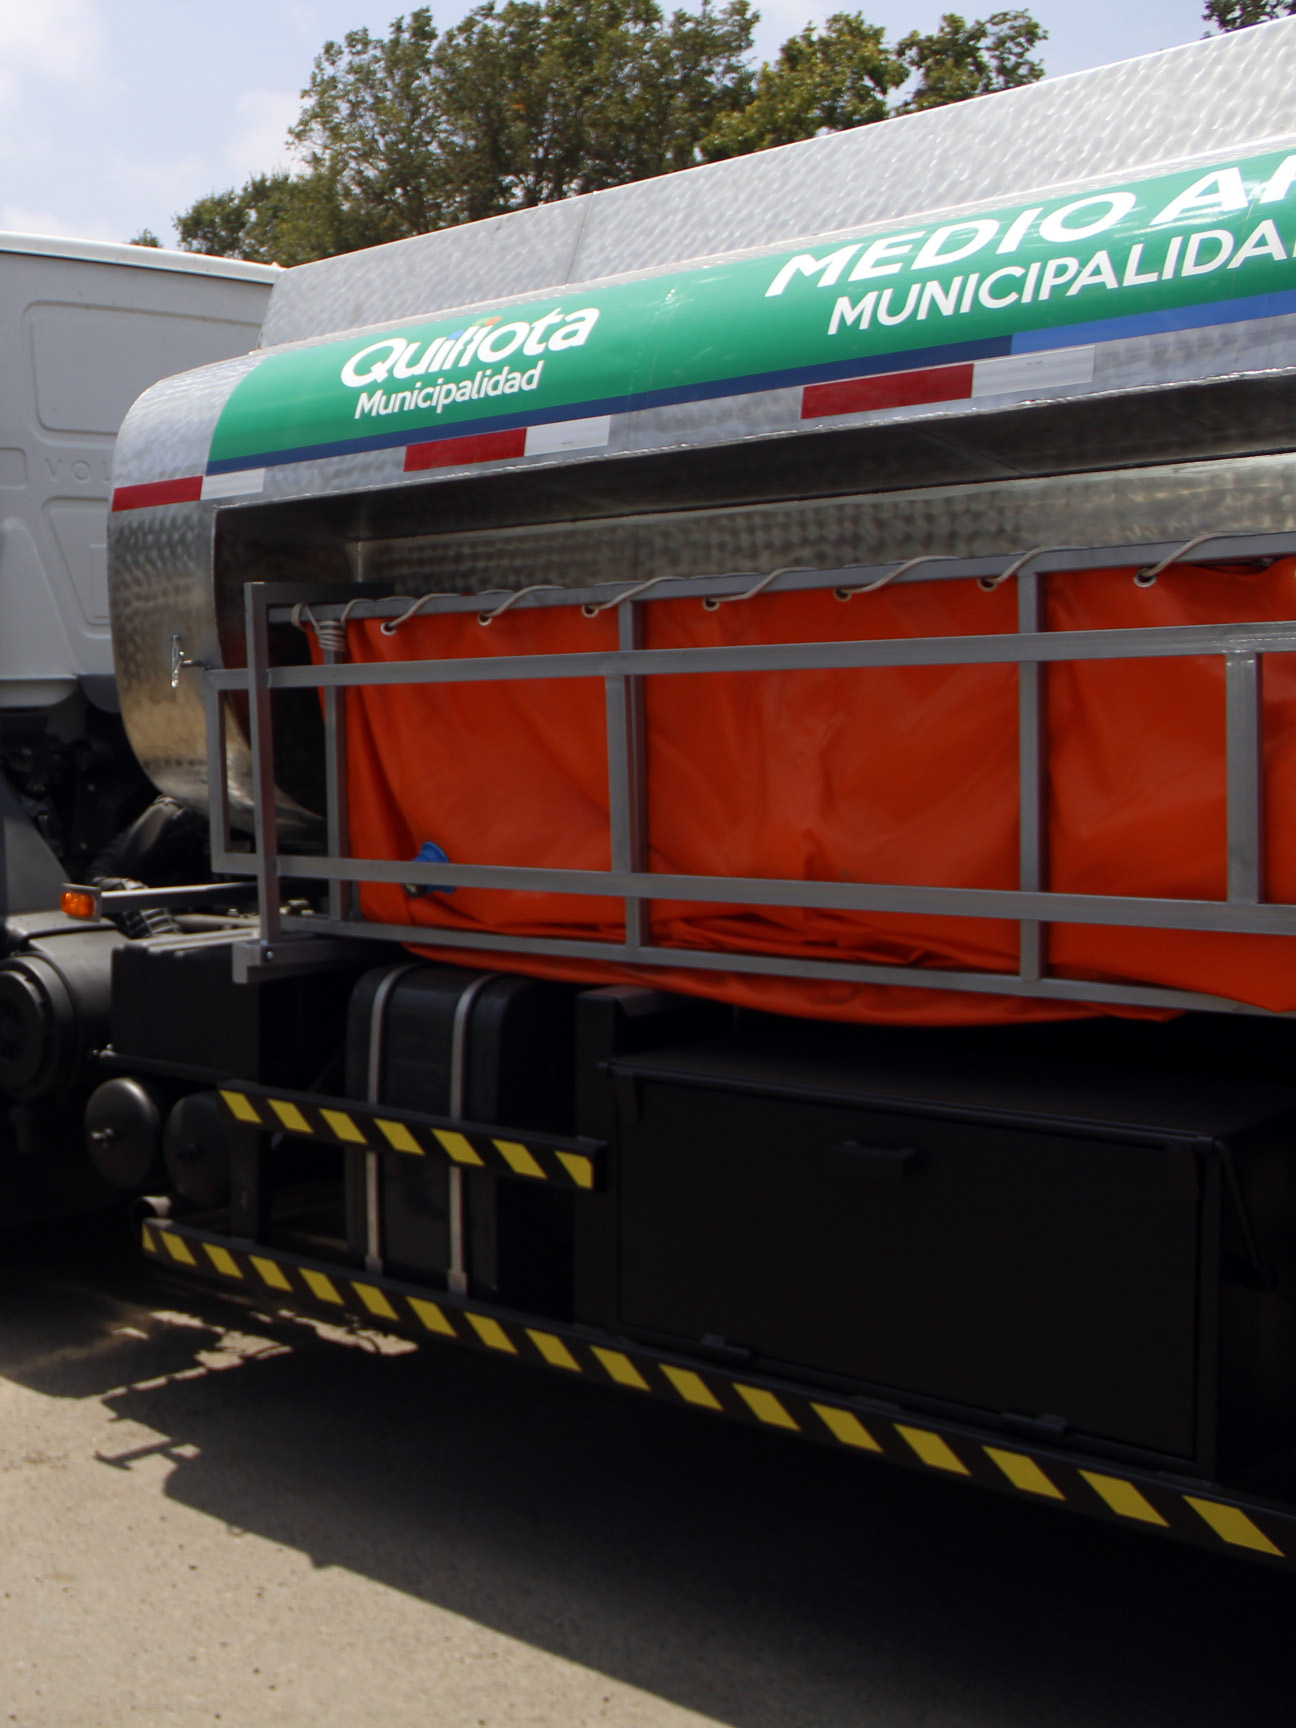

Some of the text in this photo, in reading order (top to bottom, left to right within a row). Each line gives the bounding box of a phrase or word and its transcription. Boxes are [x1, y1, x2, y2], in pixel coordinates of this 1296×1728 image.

[764, 191, 1137, 298] MEDIO
[826, 219, 1296, 336] MUNICIPALIDA
[340, 307, 601, 388] Quillota
[354, 360, 545, 419] Municipalidad
